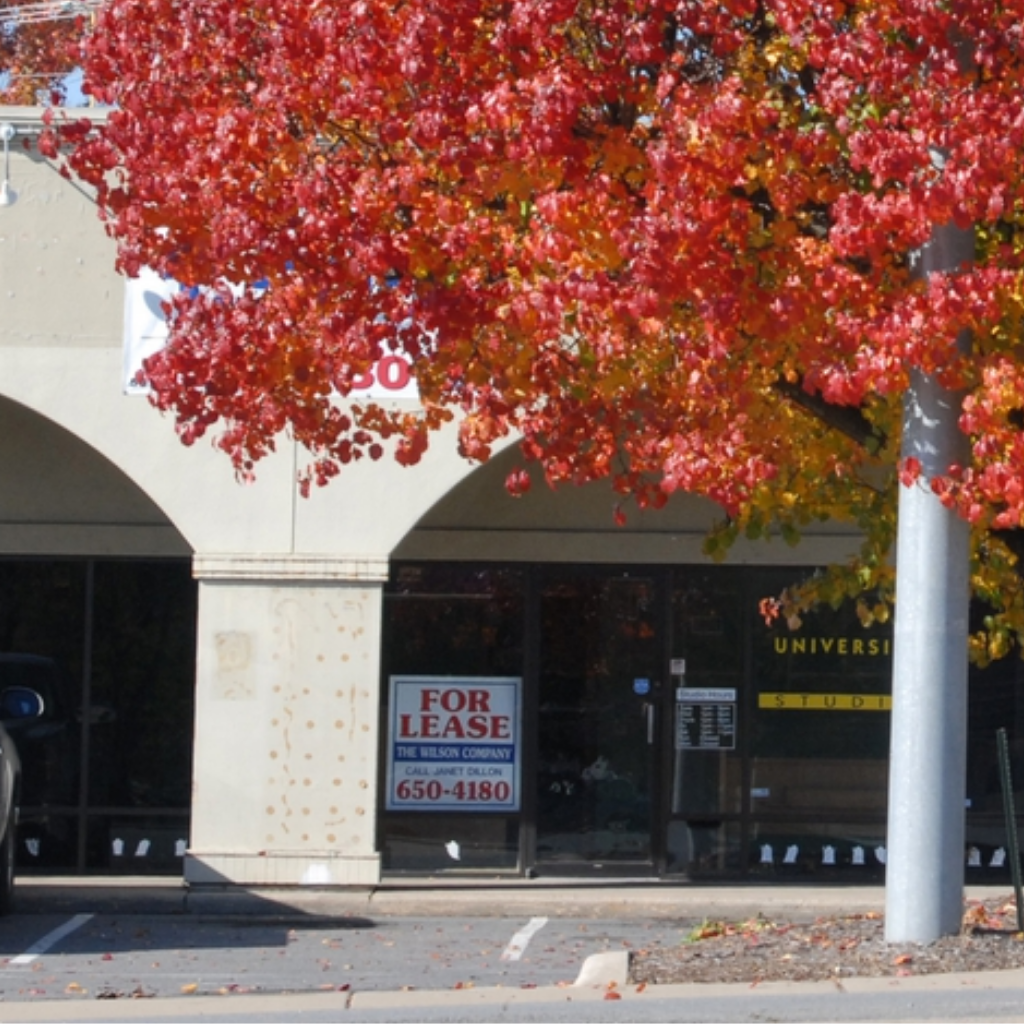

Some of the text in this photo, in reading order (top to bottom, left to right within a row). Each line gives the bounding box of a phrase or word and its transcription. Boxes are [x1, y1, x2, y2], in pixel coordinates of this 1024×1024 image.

[774, 637, 890, 655] UNIVERSI
[420, 689, 490, 712] FOR
[400, 714, 510, 738] LEASE
[398, 747, 512, 760] THE WILSON COMPANY
[405, 765, 503, 777] CALL JANET DILLON
[396, 779, 511, 802] 650-4180
